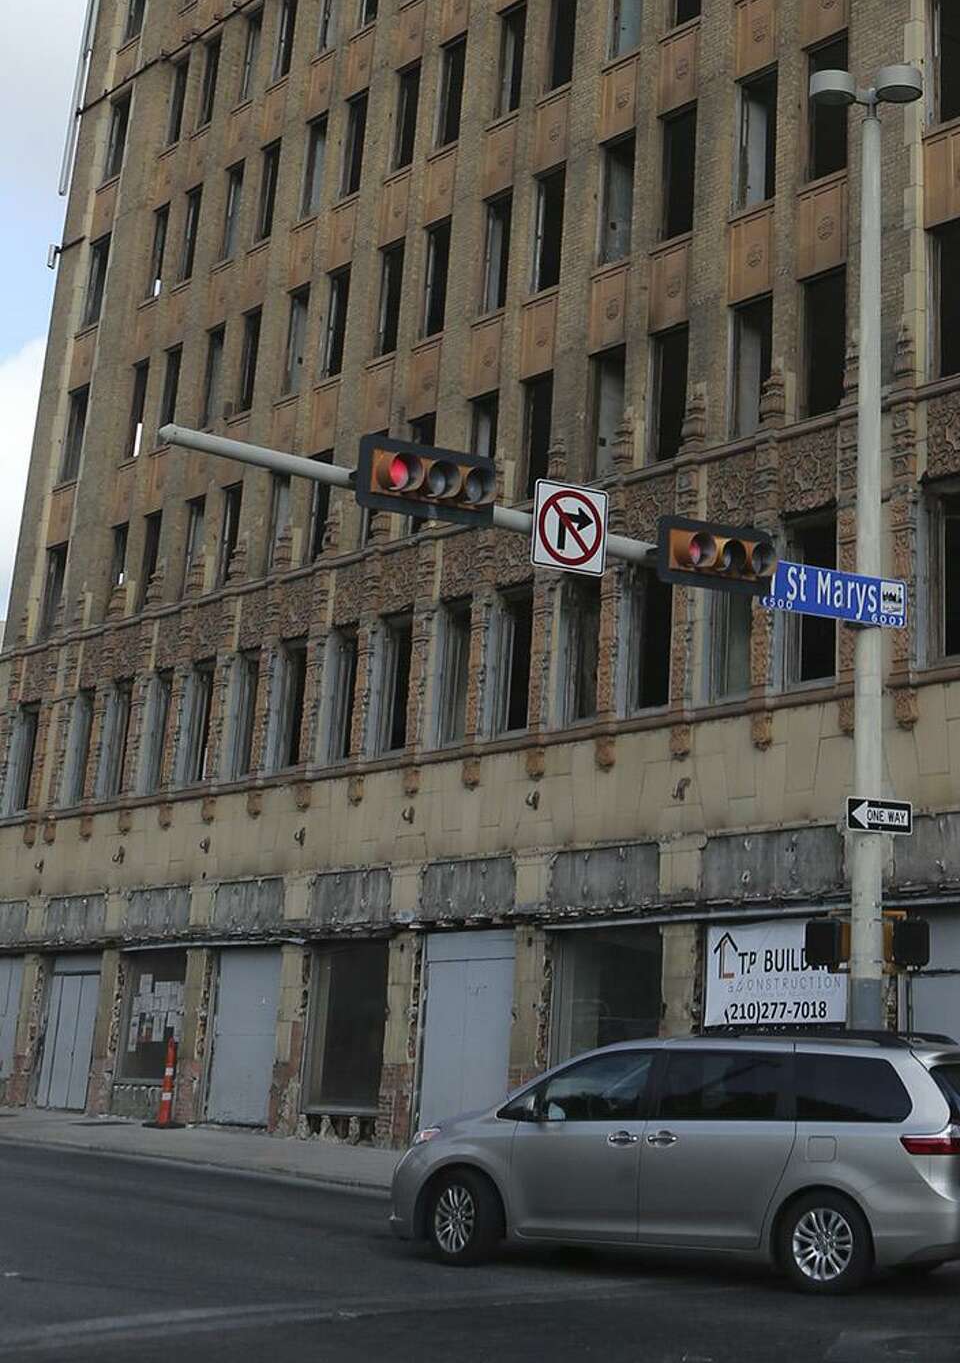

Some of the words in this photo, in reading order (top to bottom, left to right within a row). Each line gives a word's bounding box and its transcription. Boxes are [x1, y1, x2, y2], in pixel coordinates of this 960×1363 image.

[787, 566, 807, 602] St
[817, 571, 878, 620] Marys
[770, 597, 793, 611] 500
[871, 613, 896, 626] 600
[866, 808, 885, 823] ONE
[888, 810, 906, 824] WAY
[738, 950, 757, 975] TP
[764, 947, 831, 973] BUILD
[724, 1000, 827, 1025] (210)277-7018
